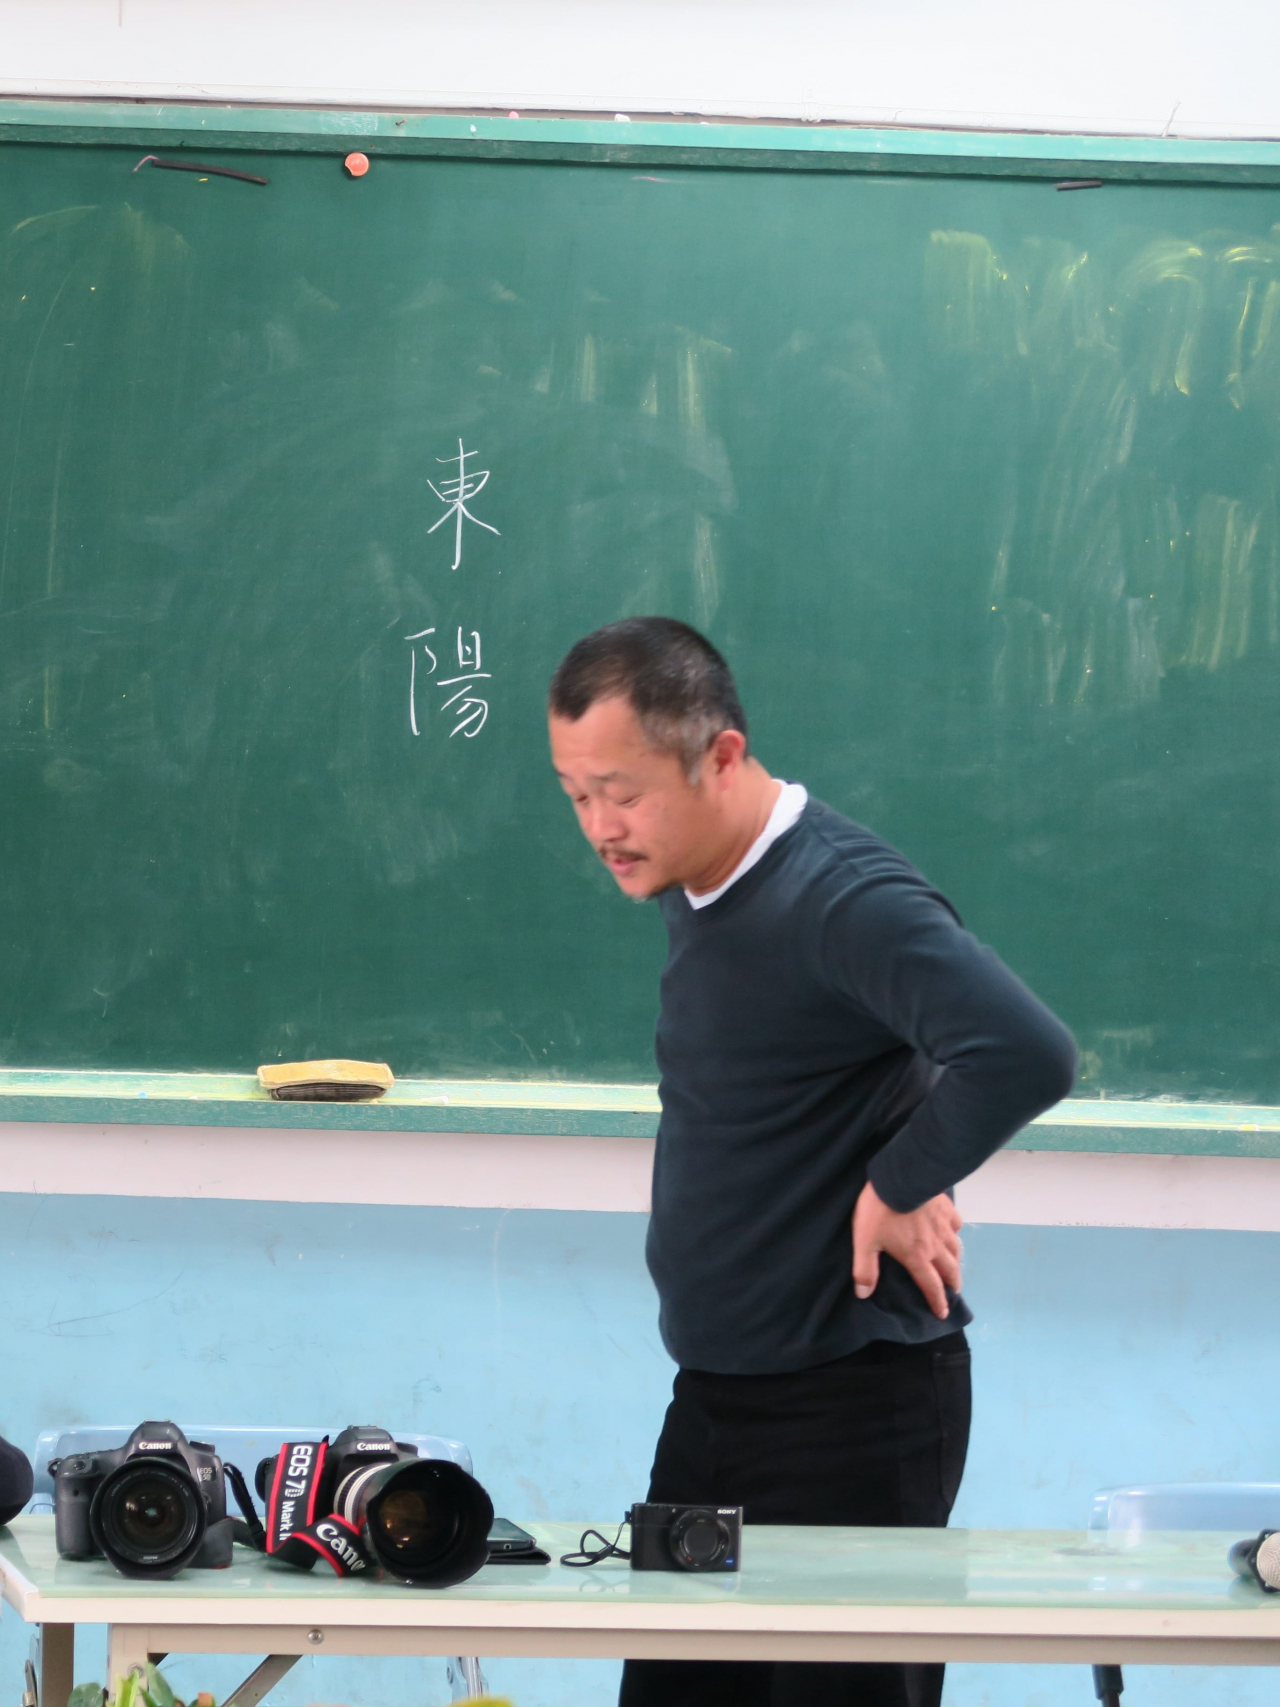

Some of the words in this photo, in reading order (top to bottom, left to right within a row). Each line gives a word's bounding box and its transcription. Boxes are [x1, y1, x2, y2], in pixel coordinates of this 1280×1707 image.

[404, 437, 501, 738] 東陽
[138, 1441, 173, 1450] Canon
[288, 1445, 313, 1477] EOS
[356, 1442, 391, 1451] Canon
[284, 1480, 307, 1497] 7D
[279, 1501, 296, 1532] Mark
[316, 1523, 366, 1571] Cano
